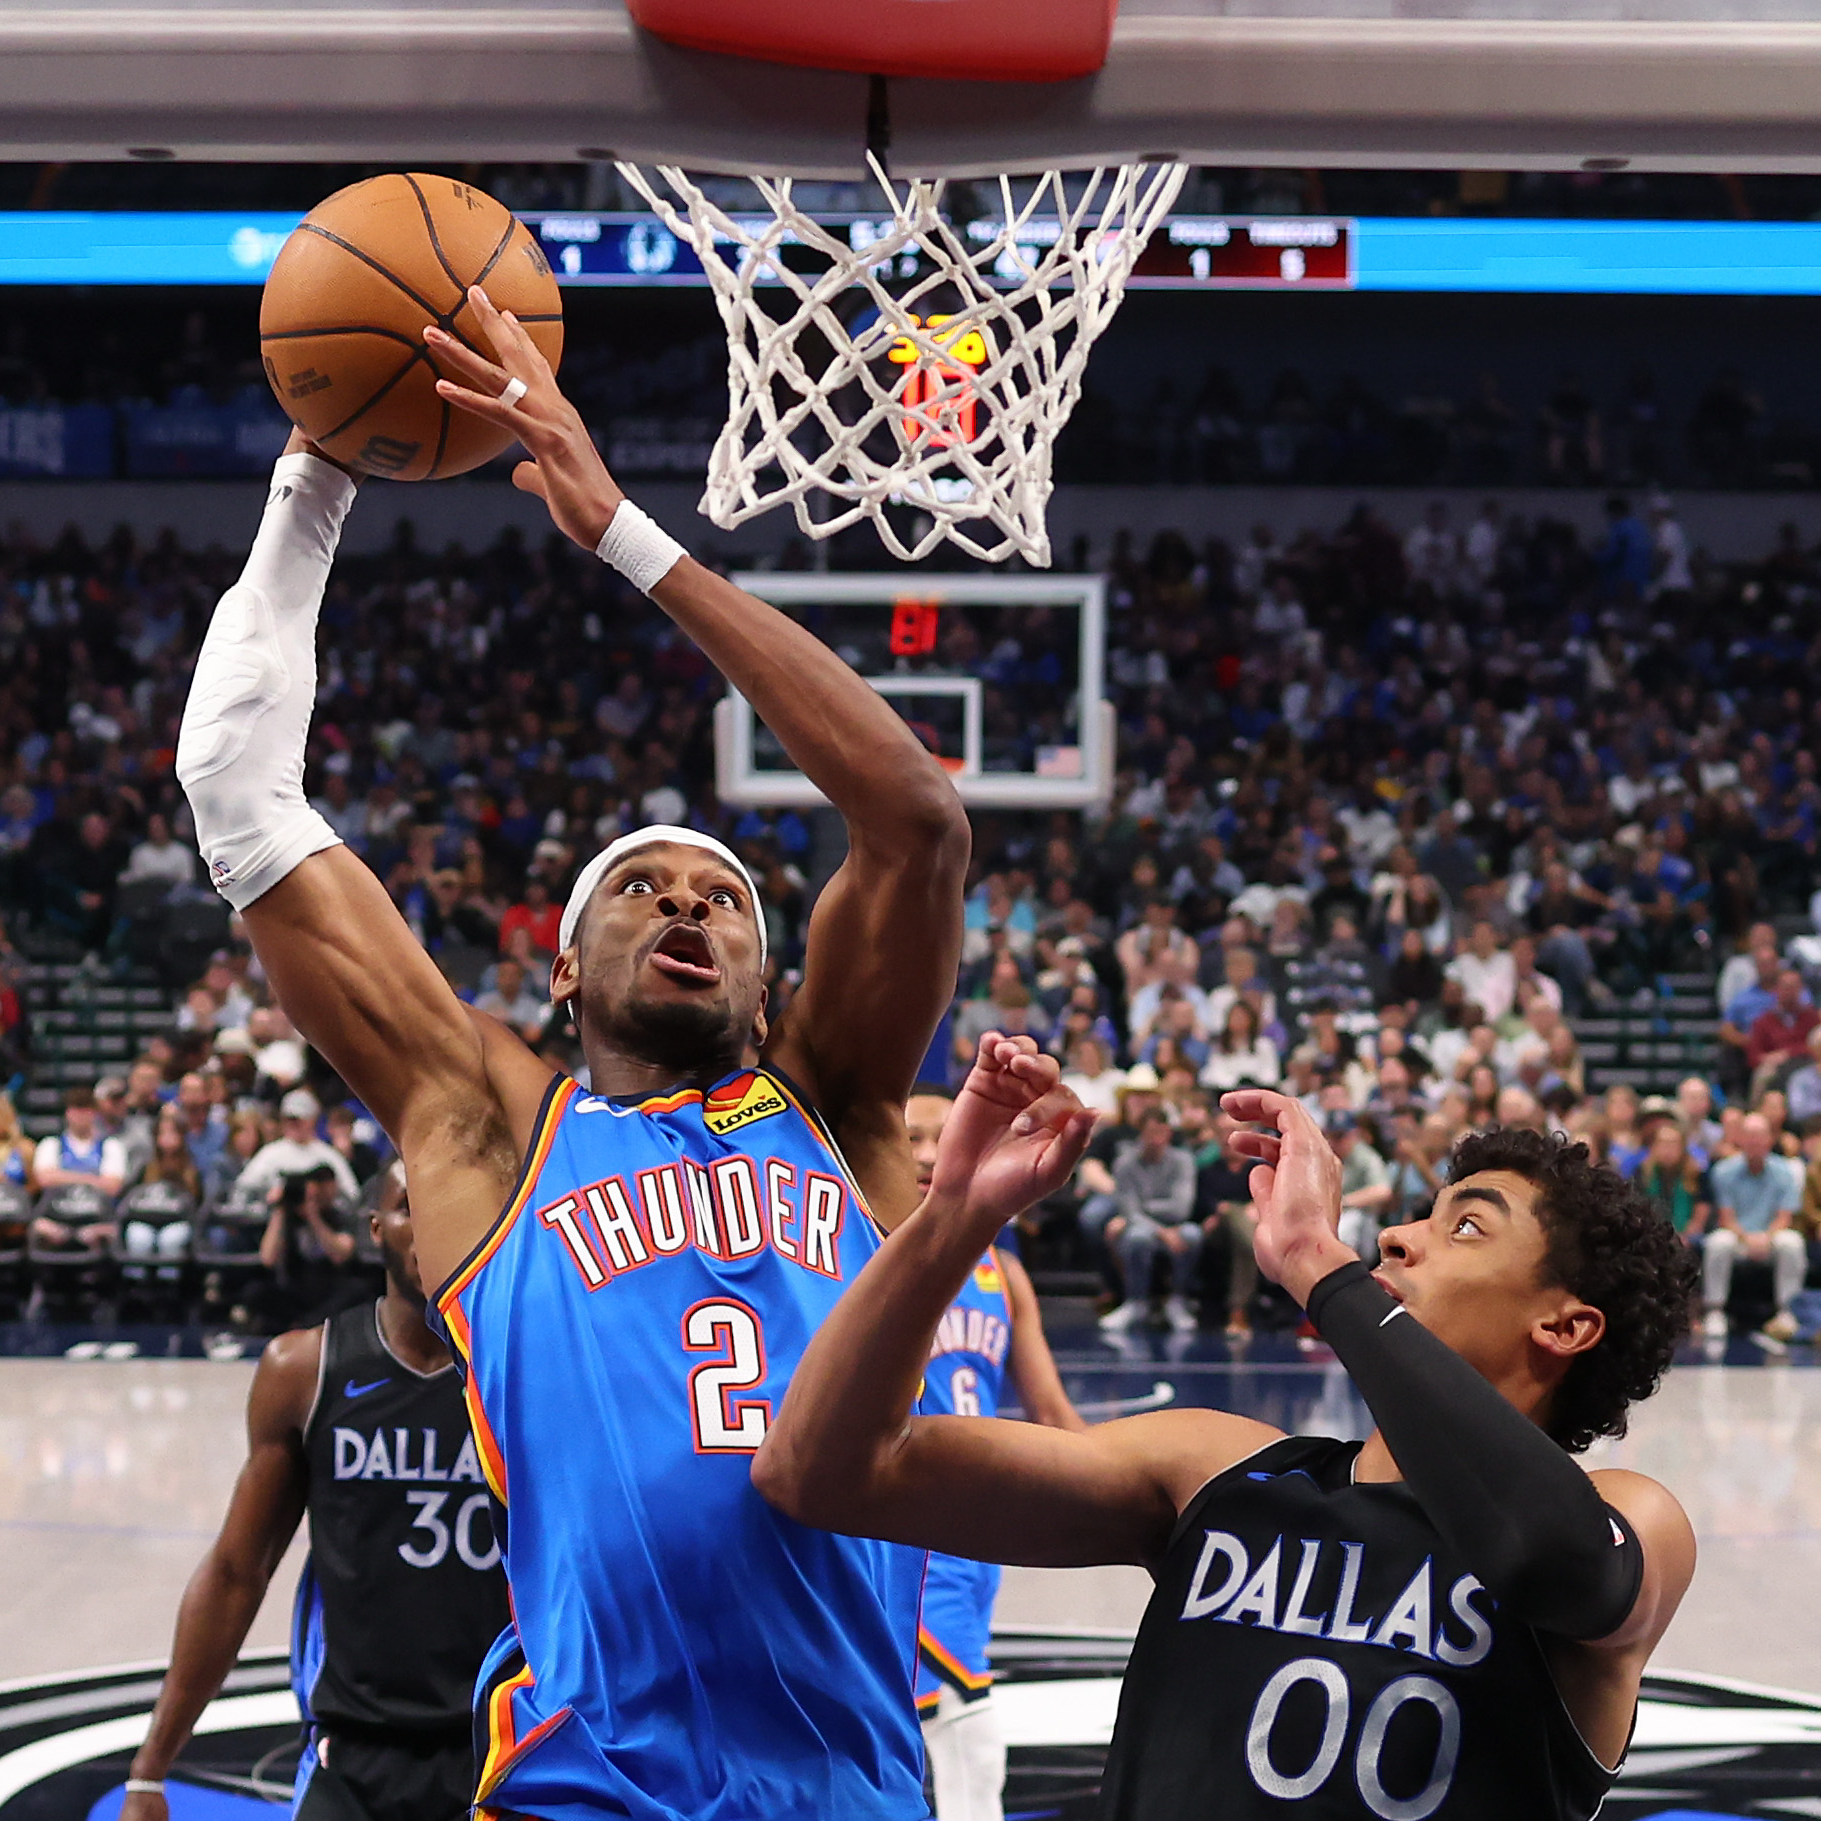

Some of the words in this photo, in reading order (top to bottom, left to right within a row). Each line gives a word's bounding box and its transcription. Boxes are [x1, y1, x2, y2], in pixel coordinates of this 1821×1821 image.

[537, 1153, 847, 1293] THUNDER
[682, 1297, 771, 1455] 2
[332, 1427, 485, 1483] DALLA
[398, 1490, 500, 1570] 30
[1180, 1528, 1497, 1669] DALLAS
